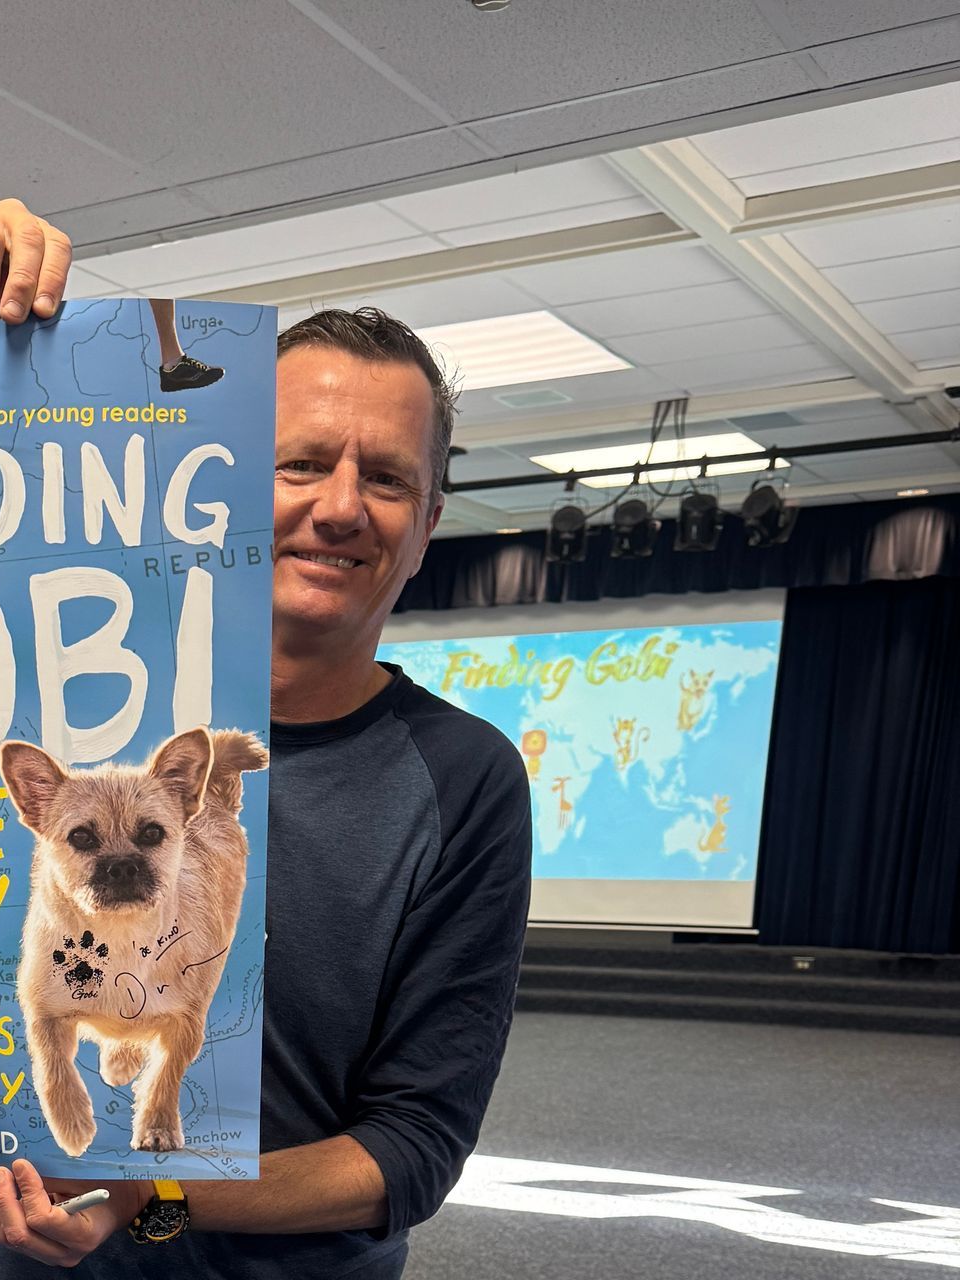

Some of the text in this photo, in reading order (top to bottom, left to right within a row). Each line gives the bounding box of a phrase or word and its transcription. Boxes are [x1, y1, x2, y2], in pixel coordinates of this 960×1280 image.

[181, 315, 217, 335] Urga
[21, 404, 95, 430] young
[101, 402, 187, 424] readers
[440, 635, 680, 701] Finding Gobi
[184, 1129, 242, 1144] anchow
[221, 1155, 248, 1178] Sian
